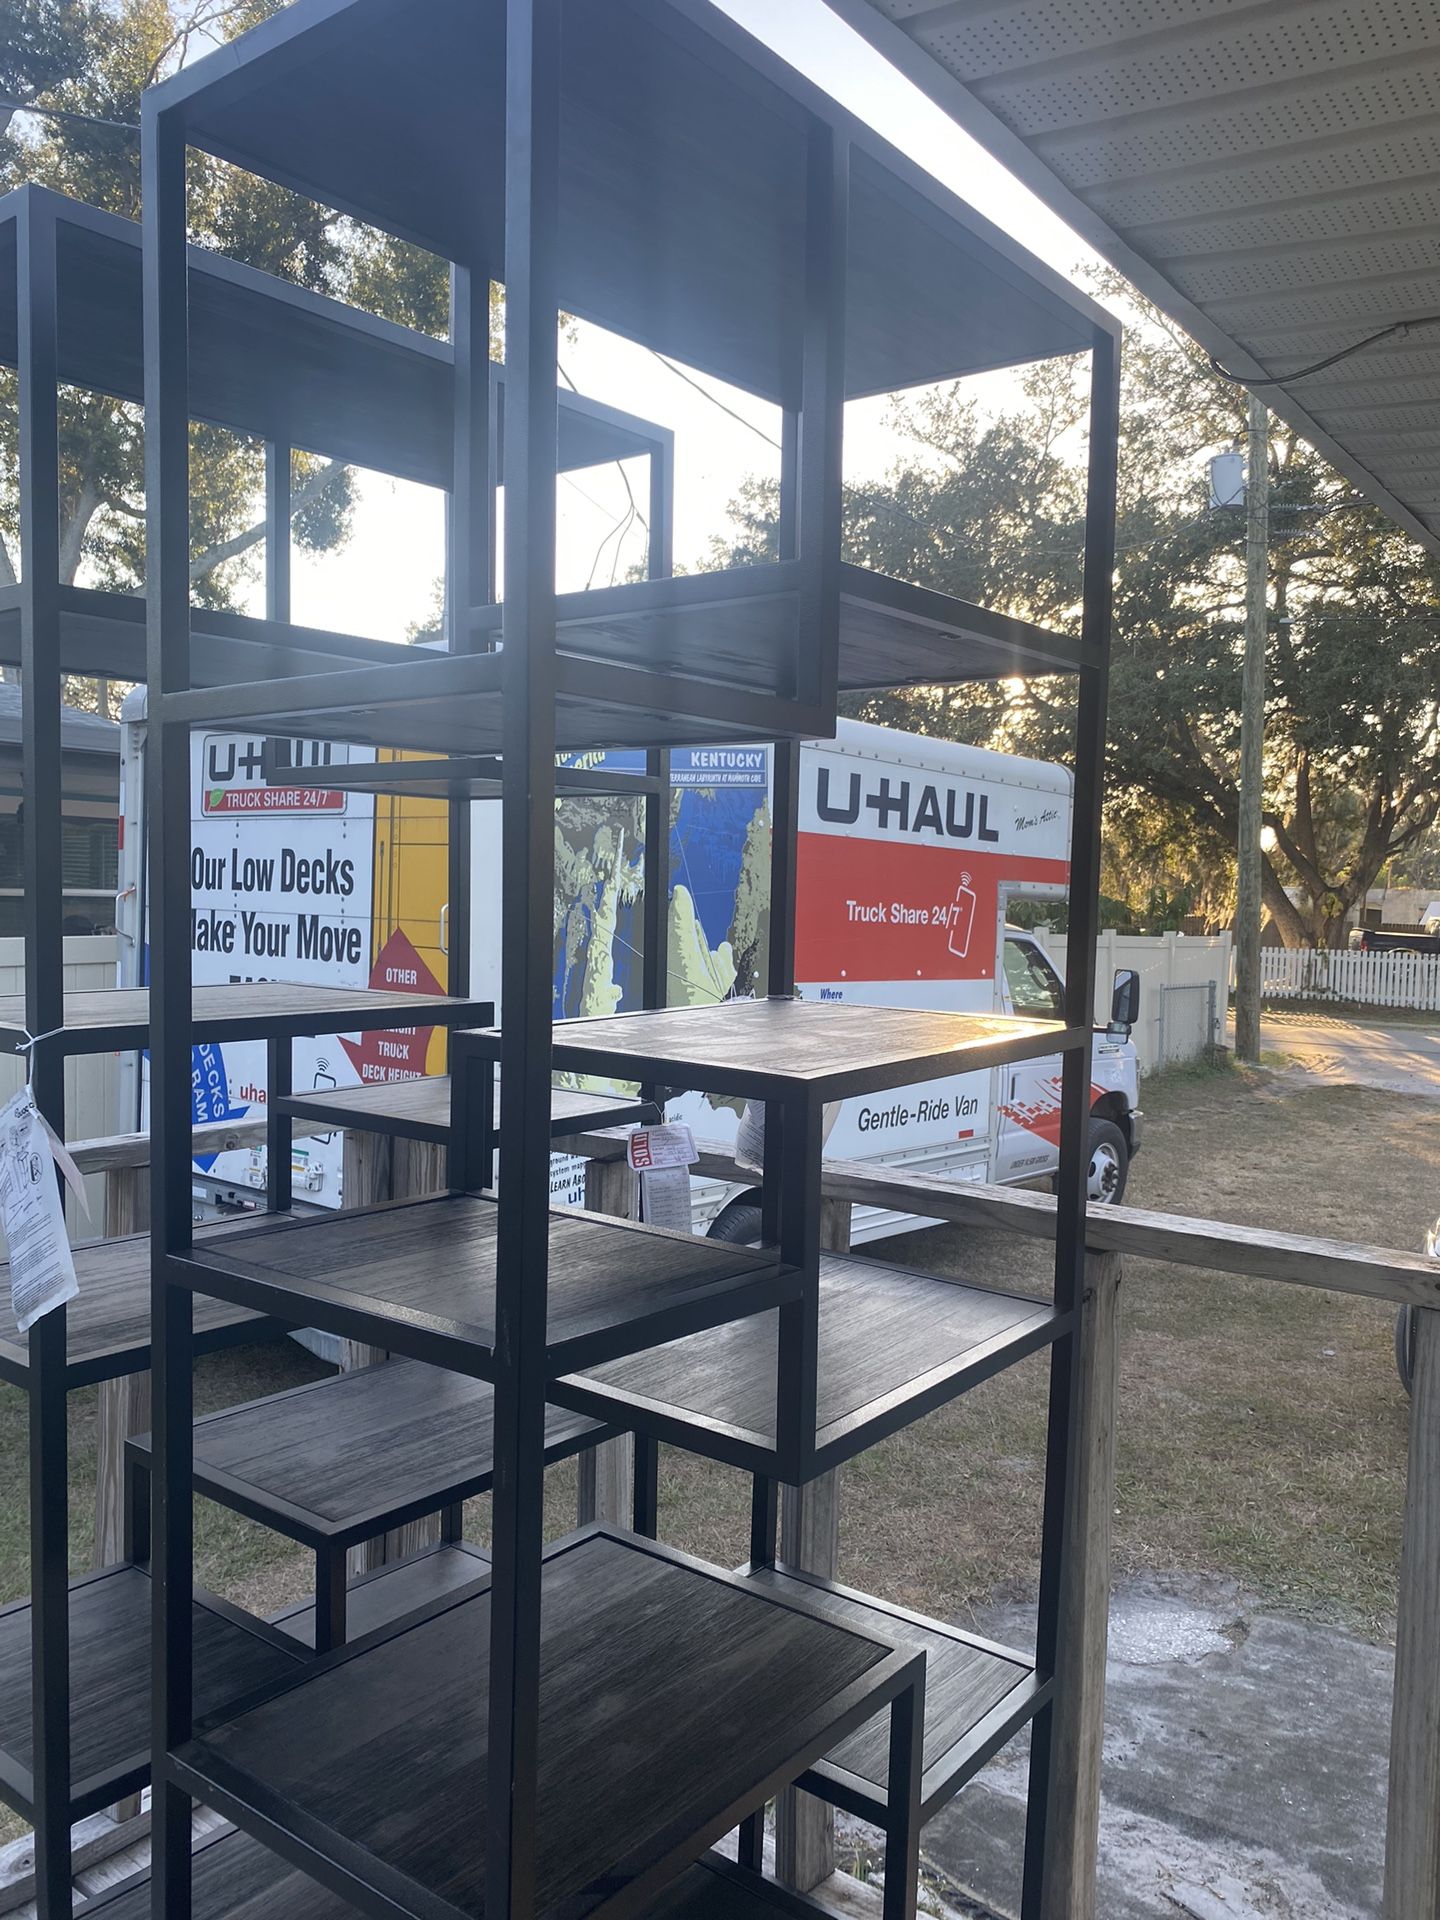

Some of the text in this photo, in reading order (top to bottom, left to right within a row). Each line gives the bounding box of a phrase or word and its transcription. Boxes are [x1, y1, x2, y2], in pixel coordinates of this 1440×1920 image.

[691, 752, 763, 768] KENTUCKY
[226, 789, 329, 808] TRUCK SHARE 24/7
[816, 766, 999, 842] U-HAUL
[192, 847, 355, 896] Our Low Decks
[846, 900, 961, 929] Truck Share 24/7
[241, 910, 290, 958] Your
[296, 914, 362, 964] Move
[385, 967, 418, 985] OTHER
[820, 988, 843, 1000] Where
[377, 1041, 410, 1060] TRUCK
[362, 1063, 387, 1081] DECK
[858, 1095, 979, 1133] Gentle-Ride Van
[633, 1132, 650, 1167] SOLD
[550, 1177, 571, 1194] LEARN
